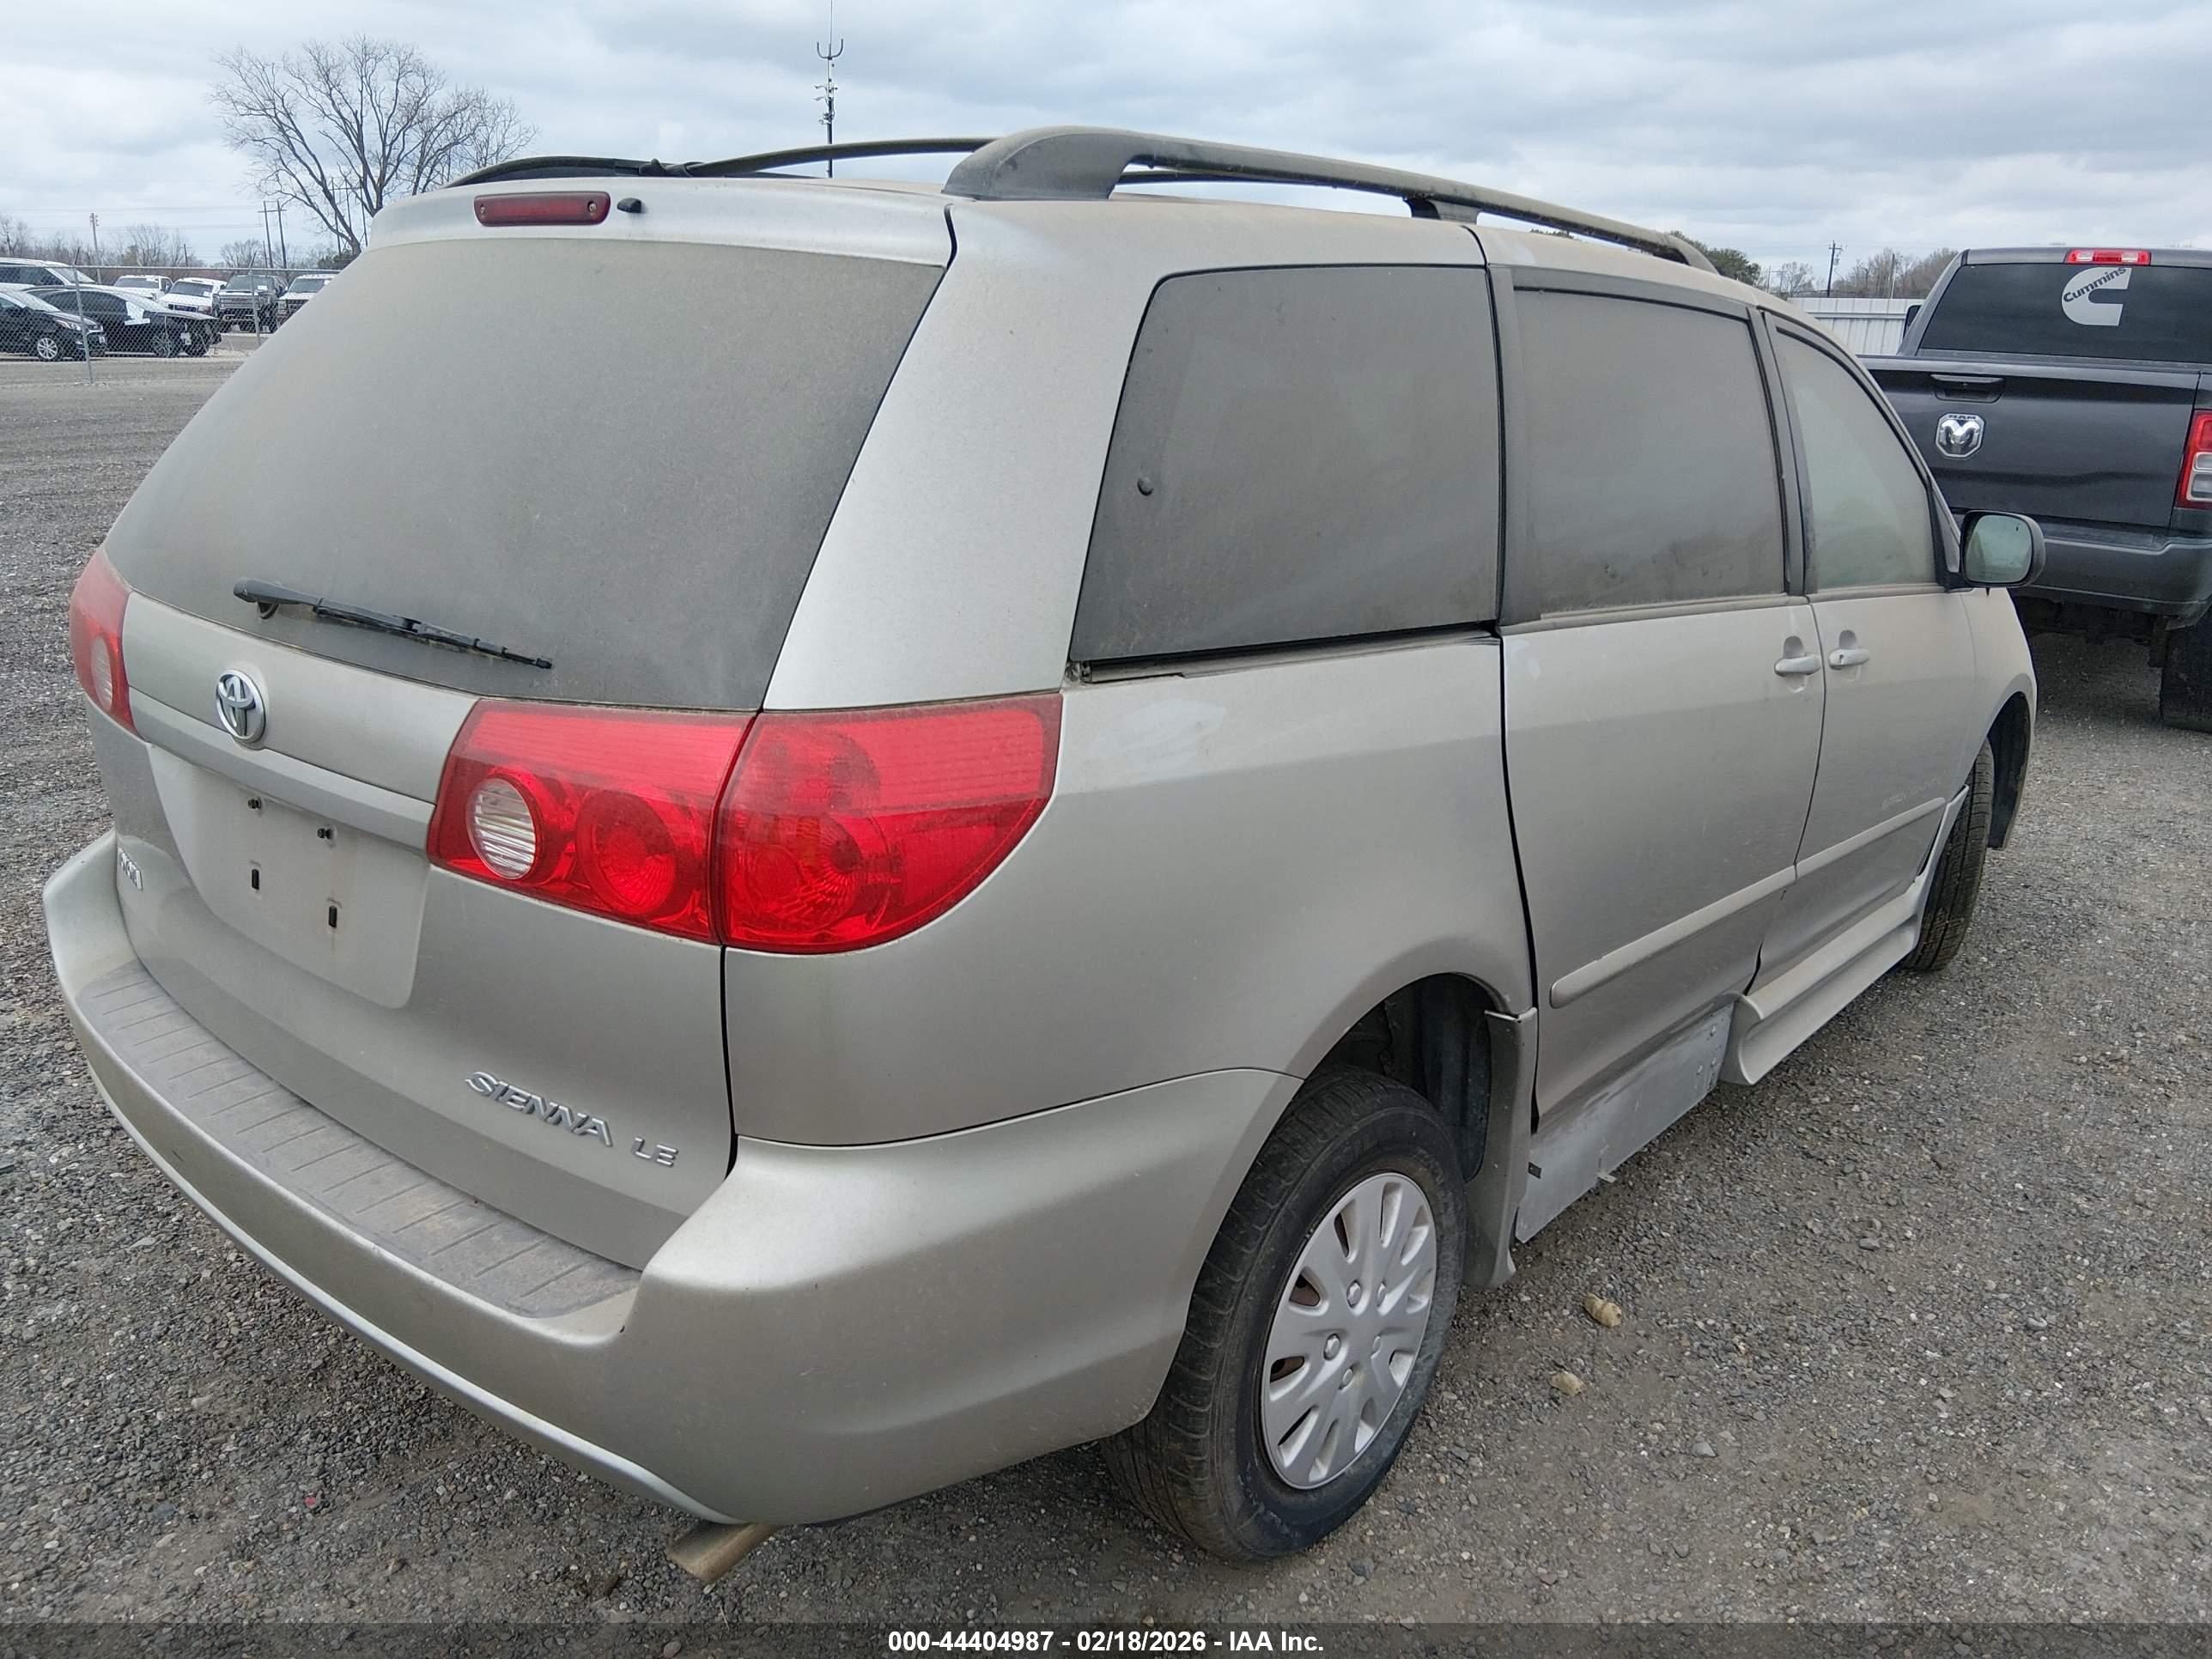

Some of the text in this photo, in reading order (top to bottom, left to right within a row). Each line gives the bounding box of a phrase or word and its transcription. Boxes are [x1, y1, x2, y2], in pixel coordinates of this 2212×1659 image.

[2063, 267, 2127, 302] Cummins
[465, 1071, 679, 1168] SIENNA LE
